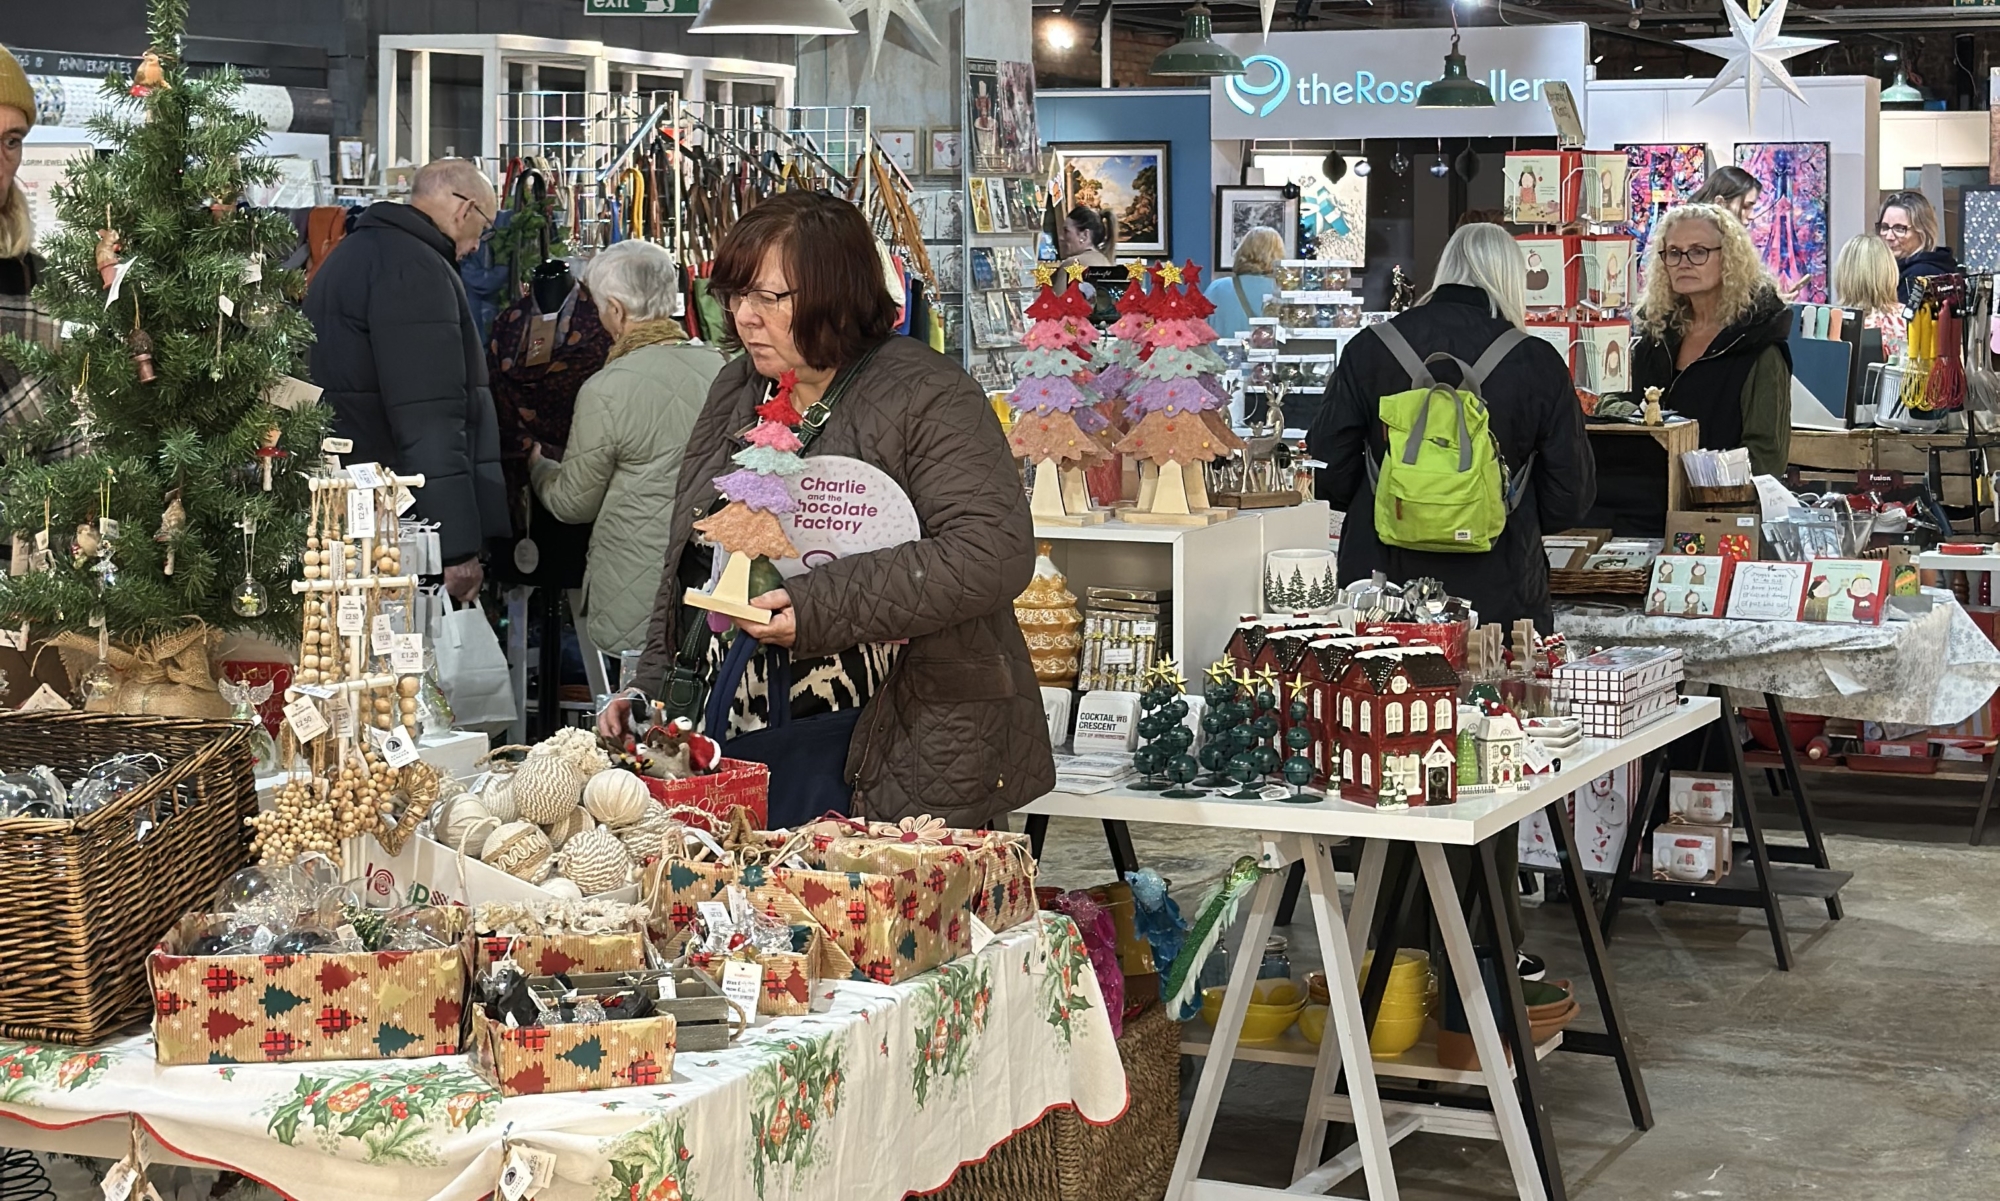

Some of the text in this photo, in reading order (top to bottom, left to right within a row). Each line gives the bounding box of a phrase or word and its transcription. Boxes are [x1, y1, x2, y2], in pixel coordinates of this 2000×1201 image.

[1869, 474, 1891, 482] Fusion
[800, 477, 866, 494] Charlie
[828, 494, 842, 502] the
[796, 499, 878, 517] hocolate
[794, 514, 862, 534] Factory
[295, 715, 312, 728] £2.50
[1080, 712, 1114, 722] COCKTAIL
[1078, 721, 1117, 731] CRESCENT
[663, 780, 696, 792] Season's
